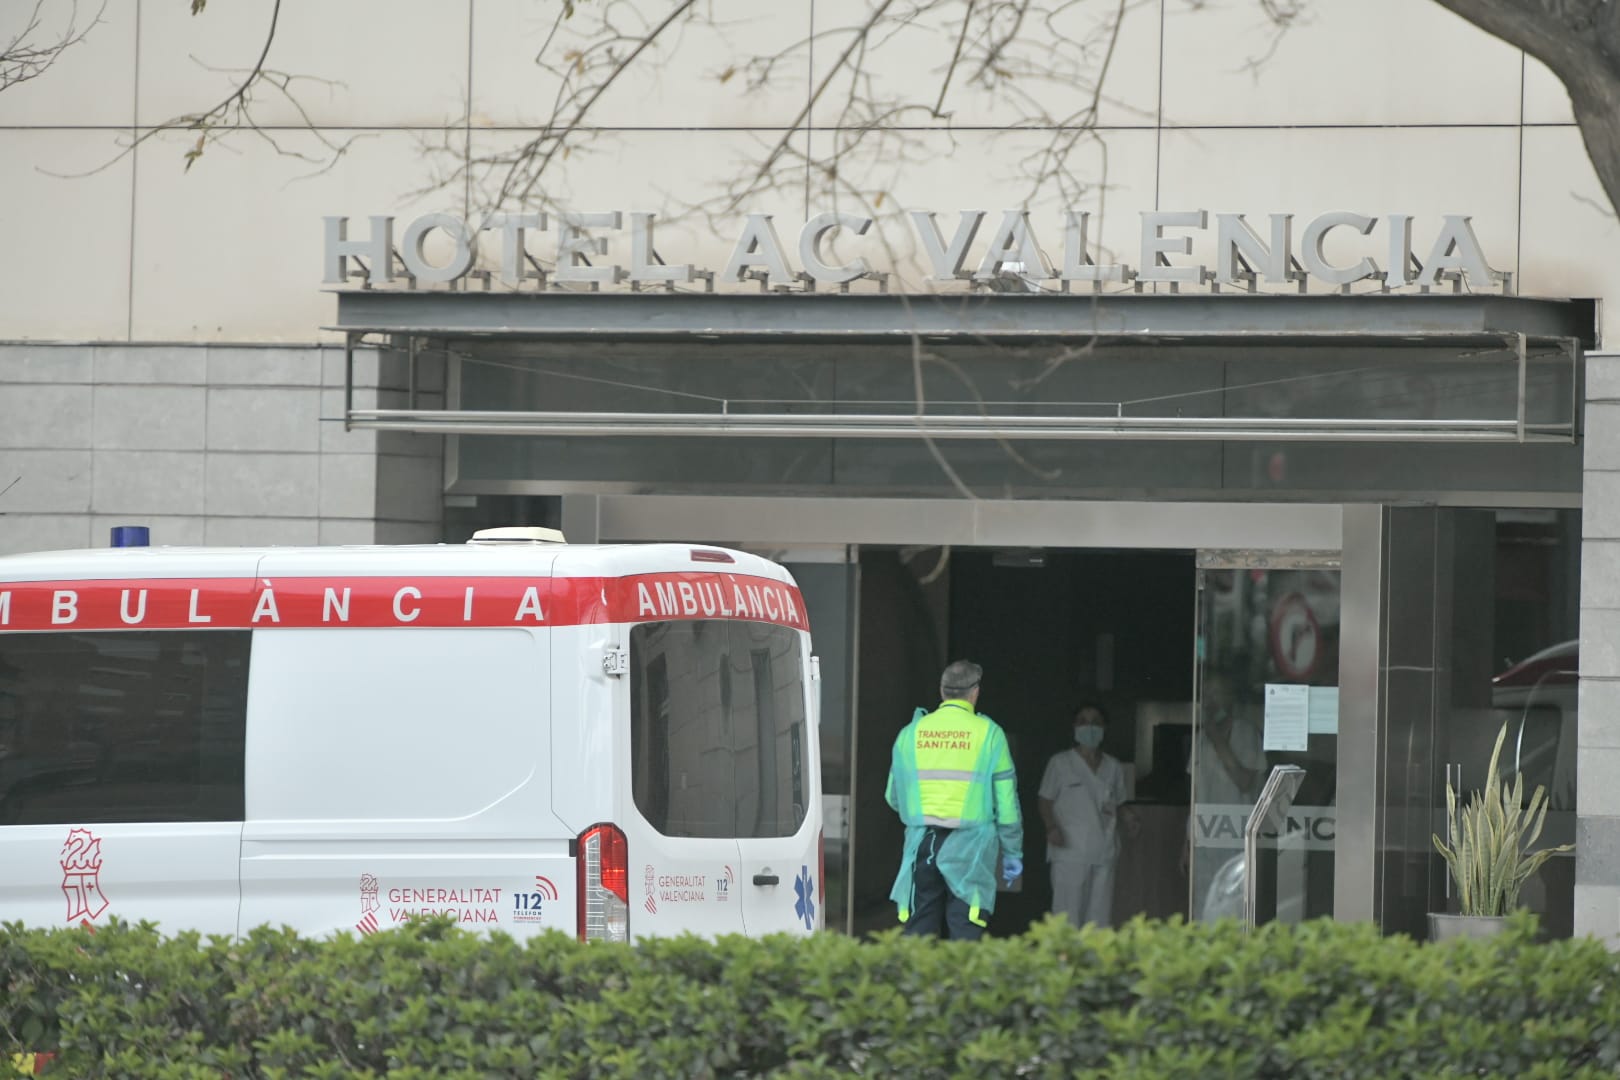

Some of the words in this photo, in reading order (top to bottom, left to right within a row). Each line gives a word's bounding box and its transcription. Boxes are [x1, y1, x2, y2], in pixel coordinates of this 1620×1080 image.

[321, 210, 695, 284] HOTEL
[722, 212, 874, 284] AC
[909, 208, 1499, 287] VALENCIA
[637, 574, 800, 623] AMBULÀNCIA
[918, 730, 972, 740] TRANSPORT
[916, 740, 971, 751] SANITARI
[658, 876, 706, 887] GENERALITAT
[717, 878, 728, 891] 112
[388, 888, 502, 903] GENERALITAT
[513, 893, 542, 910] 112
[660, 890, 705, 902] VALENCIANA
